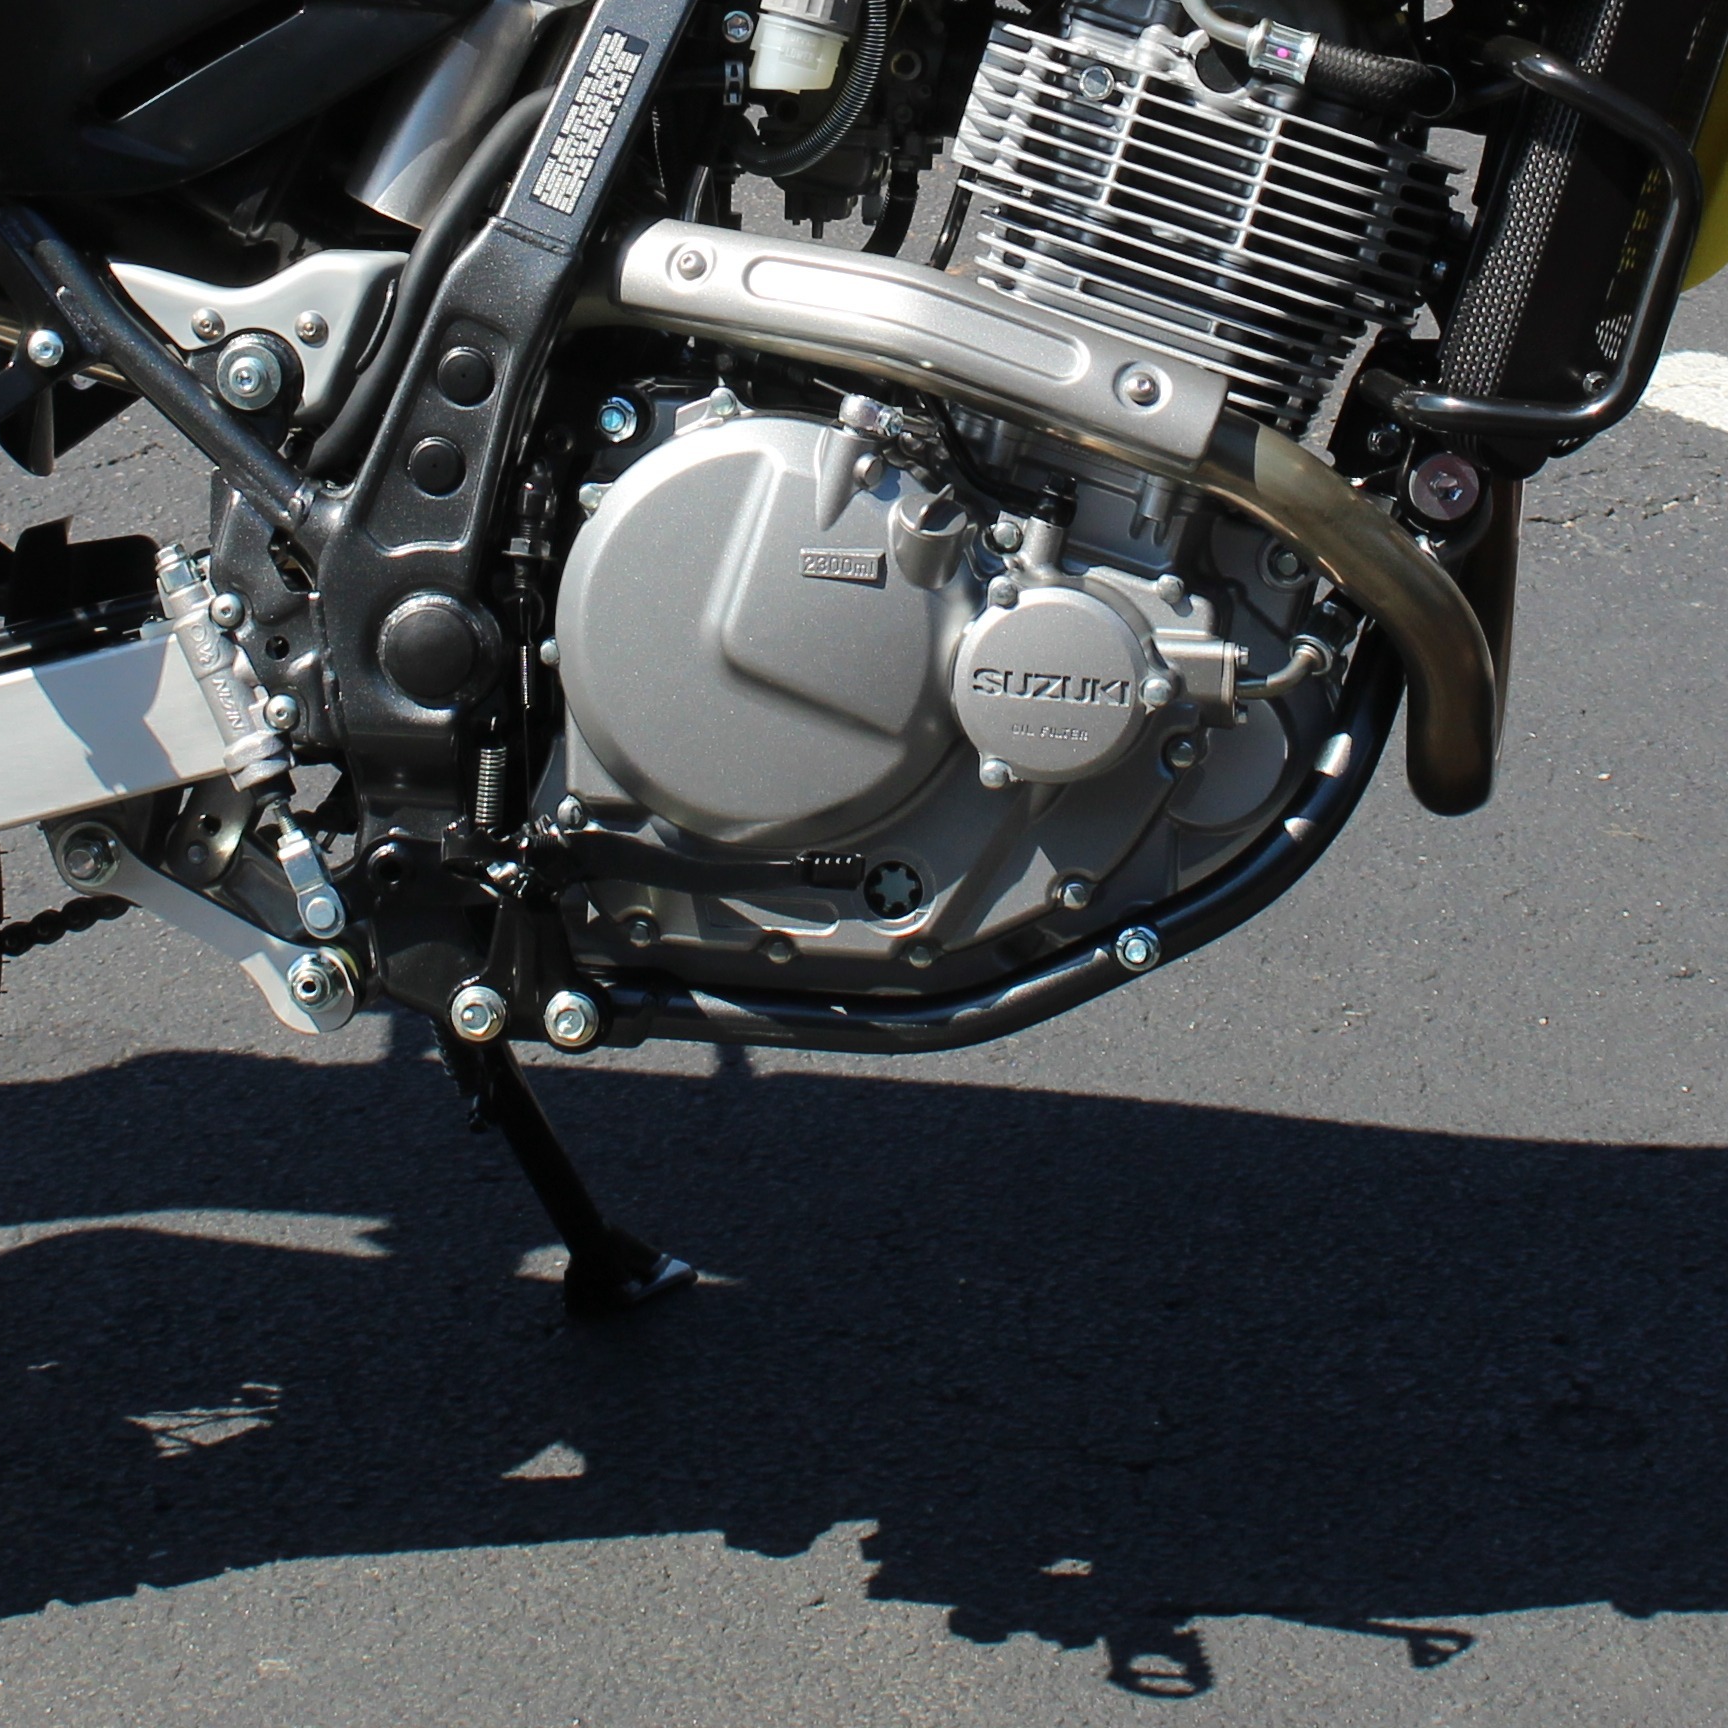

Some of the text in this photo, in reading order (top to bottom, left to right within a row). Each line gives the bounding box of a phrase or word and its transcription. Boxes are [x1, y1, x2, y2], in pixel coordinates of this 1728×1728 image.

[802, 555, 875, 578] 2300ml
[972, 667, 1131, 708] SUZUKI
[1011, 723, 1090, 743] OIL FILTER
